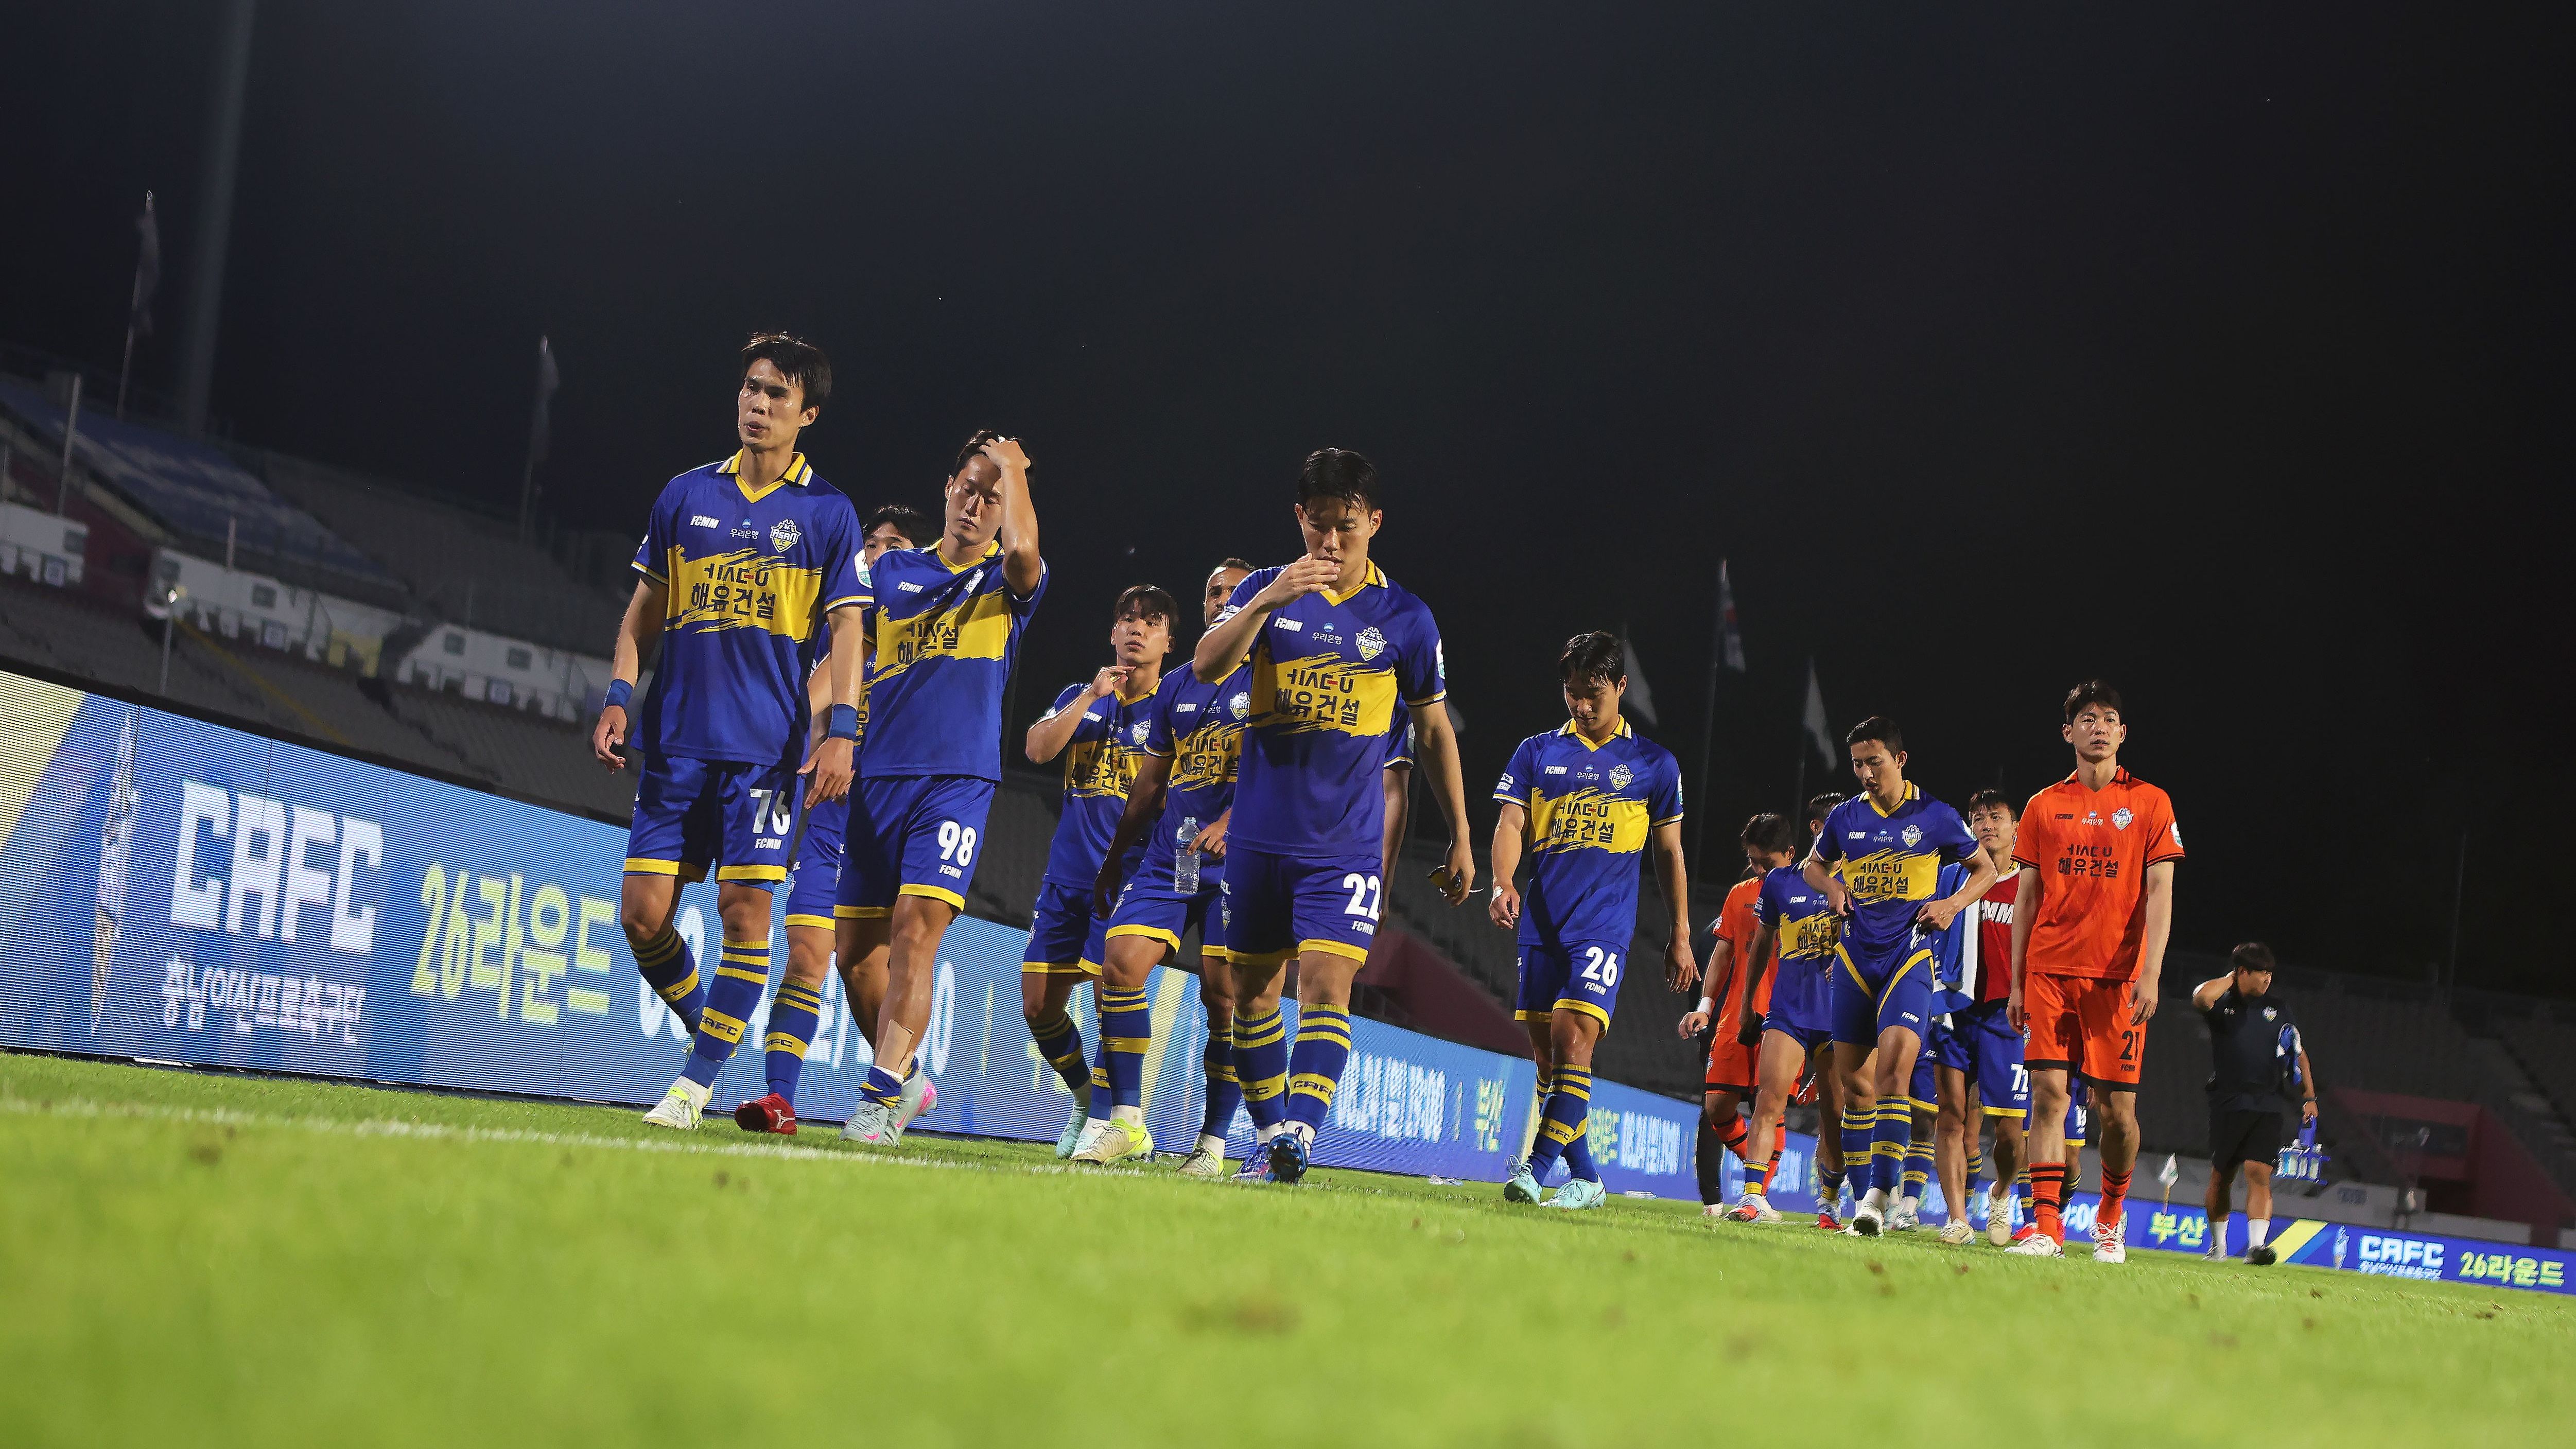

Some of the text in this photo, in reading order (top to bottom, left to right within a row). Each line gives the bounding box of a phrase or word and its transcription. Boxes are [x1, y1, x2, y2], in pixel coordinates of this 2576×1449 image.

[690, 515, 720, 529] FCMM
[730, 529, 759, 539] 우리은행
[773, 528, 797, 543] ASAN
[898, 582, 924, 593] FCMM
[691, 583, 776, 619] 해유건설
[1274, 617, 1303, 632] FCMM
[1312, 632, 1343, 645] 우리은행
[1359, 636, 1383, 650] ASAN
[1176, 704, 1197, 712] FCMM
[1275, 688, 1360, 726] 해유건설
[1083, 711, 1102, 723] CMM
[1545, 765, 1568, 775] FCMM
[1576, 772, 1599, 780] 우리은행
[750, 789, 791, 835] 76
[1552, 818, 1614, 844] 해유건설
[755, 837, 782, 850] FCMM
[938, 821, 977, 867] 98
[170, 780, 384, 953] CAFC
[939, 865, 963, 879] FCMM
[2058, 857, 2118, 878] 해유건설
[1853, 876, 1909, 894] 해유건설
[1343, 874, 1381, 921] 22
[1352, 920, 1374, 935] FCMM
[410, 863, 615, 1024] 26라운드
[1580, 947, 1617, 987] 26
[1584, 982, 1607, 996] FCMM
[162, 953, 366, 1045] 충남아산프로축구단
[2119, 1031, 2139, 1061] 21
[2150, 1212, 2207, 1246] 부산
[2359, 1235, 2445, 1269] CAFC
[2459, 1251, 2565, 1287] 26라운드
